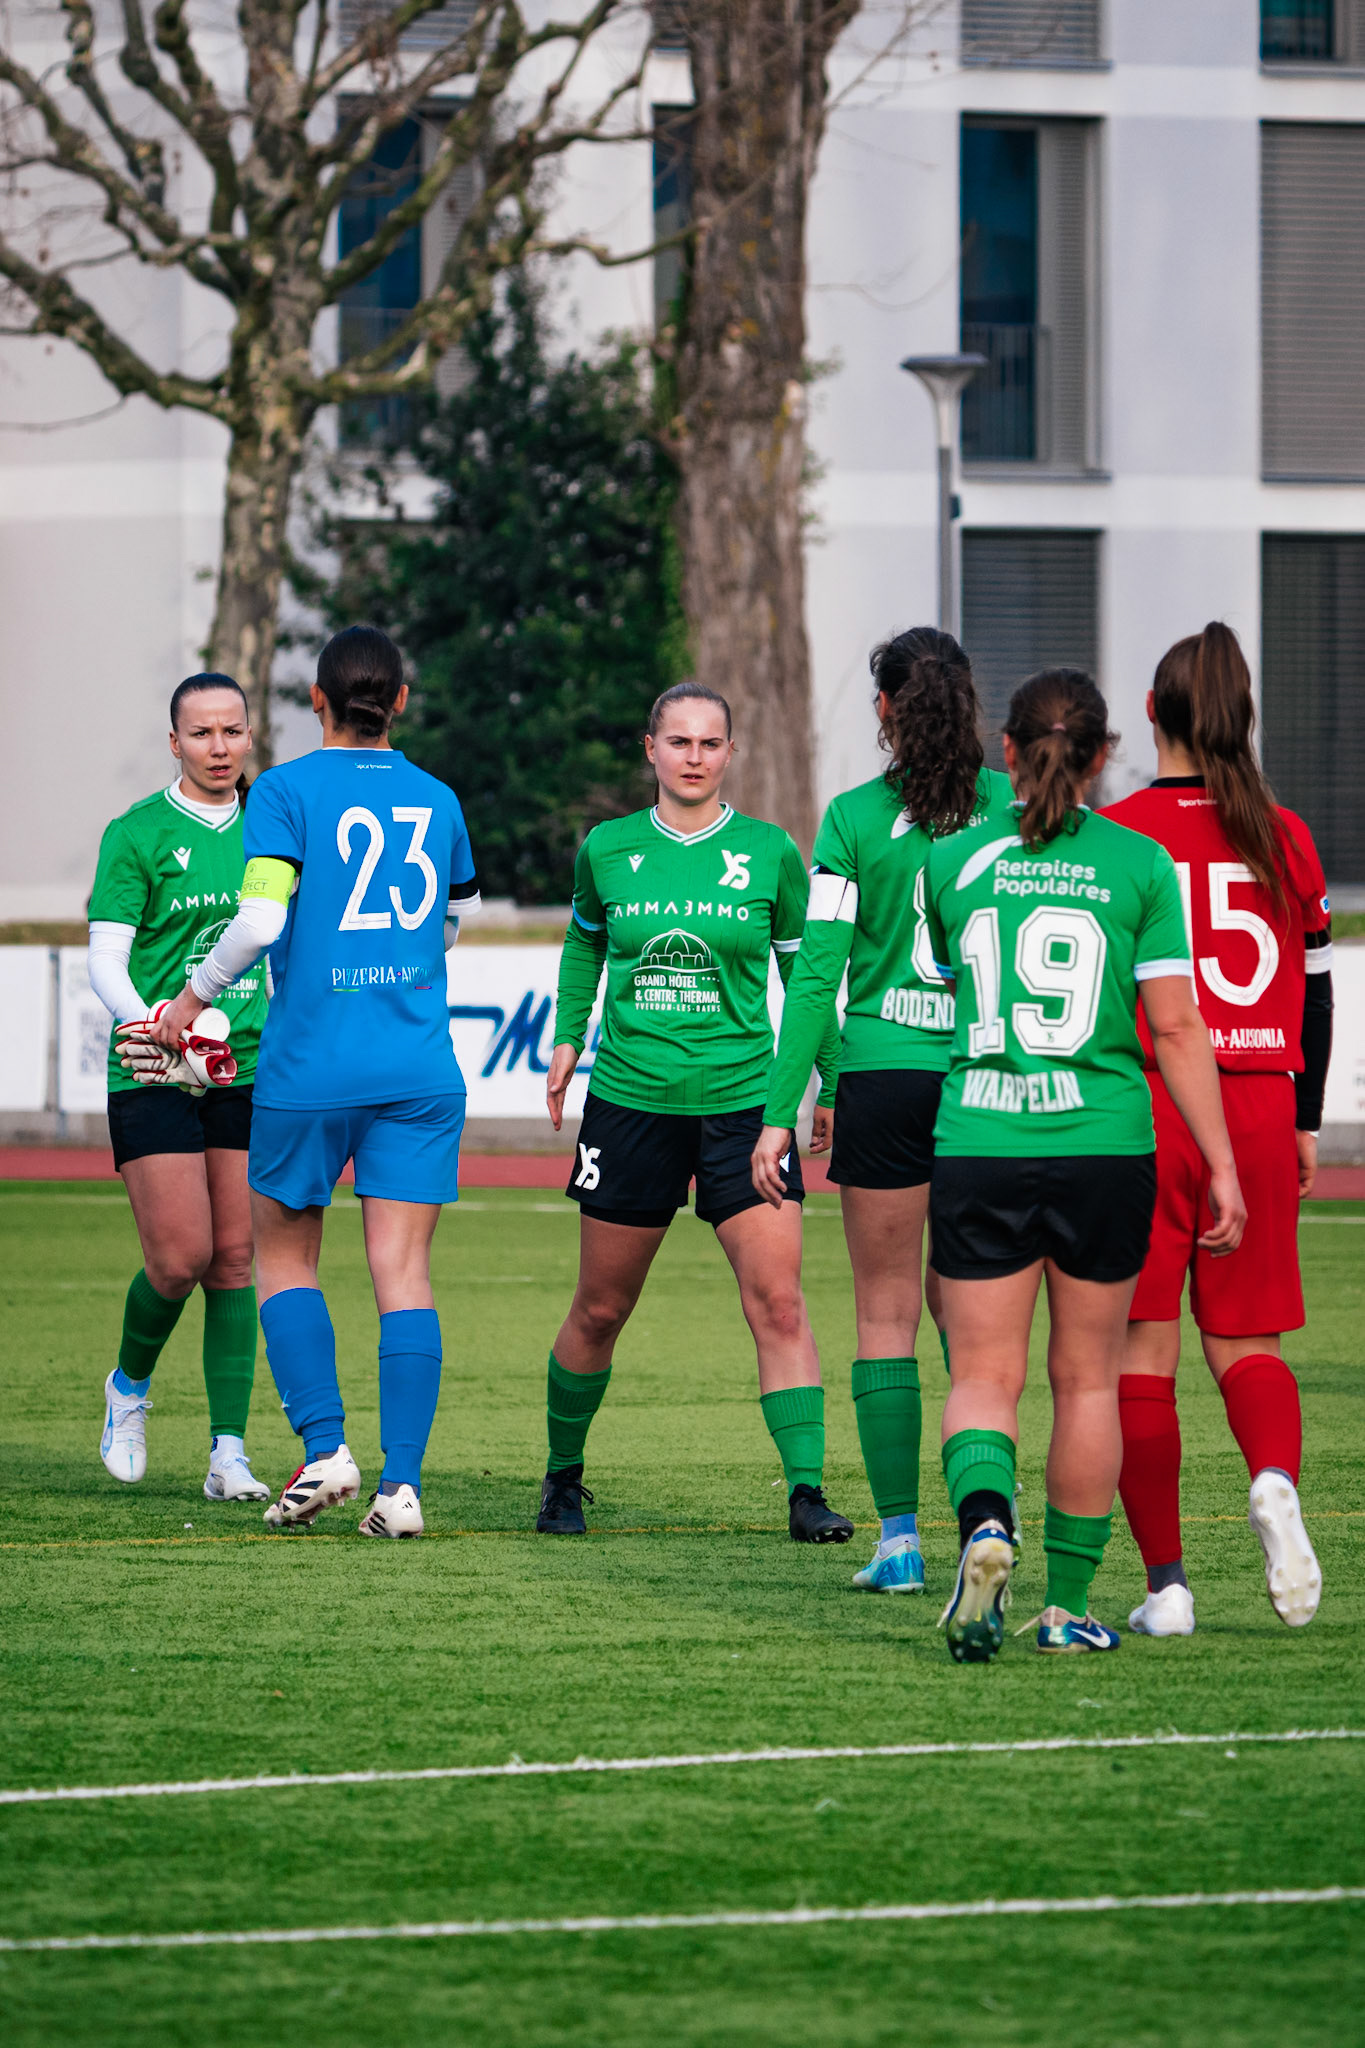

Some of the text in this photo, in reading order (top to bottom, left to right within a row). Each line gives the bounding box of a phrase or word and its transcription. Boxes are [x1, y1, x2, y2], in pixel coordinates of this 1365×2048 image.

[336, 806, 438, 931] 23
[994, 859, 1096, 881] Retraites
[993, 877, 1112, 903] Populaires
[634, 973, 698, 989] GRAND HÔTEL
[959, 905, 1107, 1058] 19
[635, 988, 721, 1004] & CENTRE THERMAL
